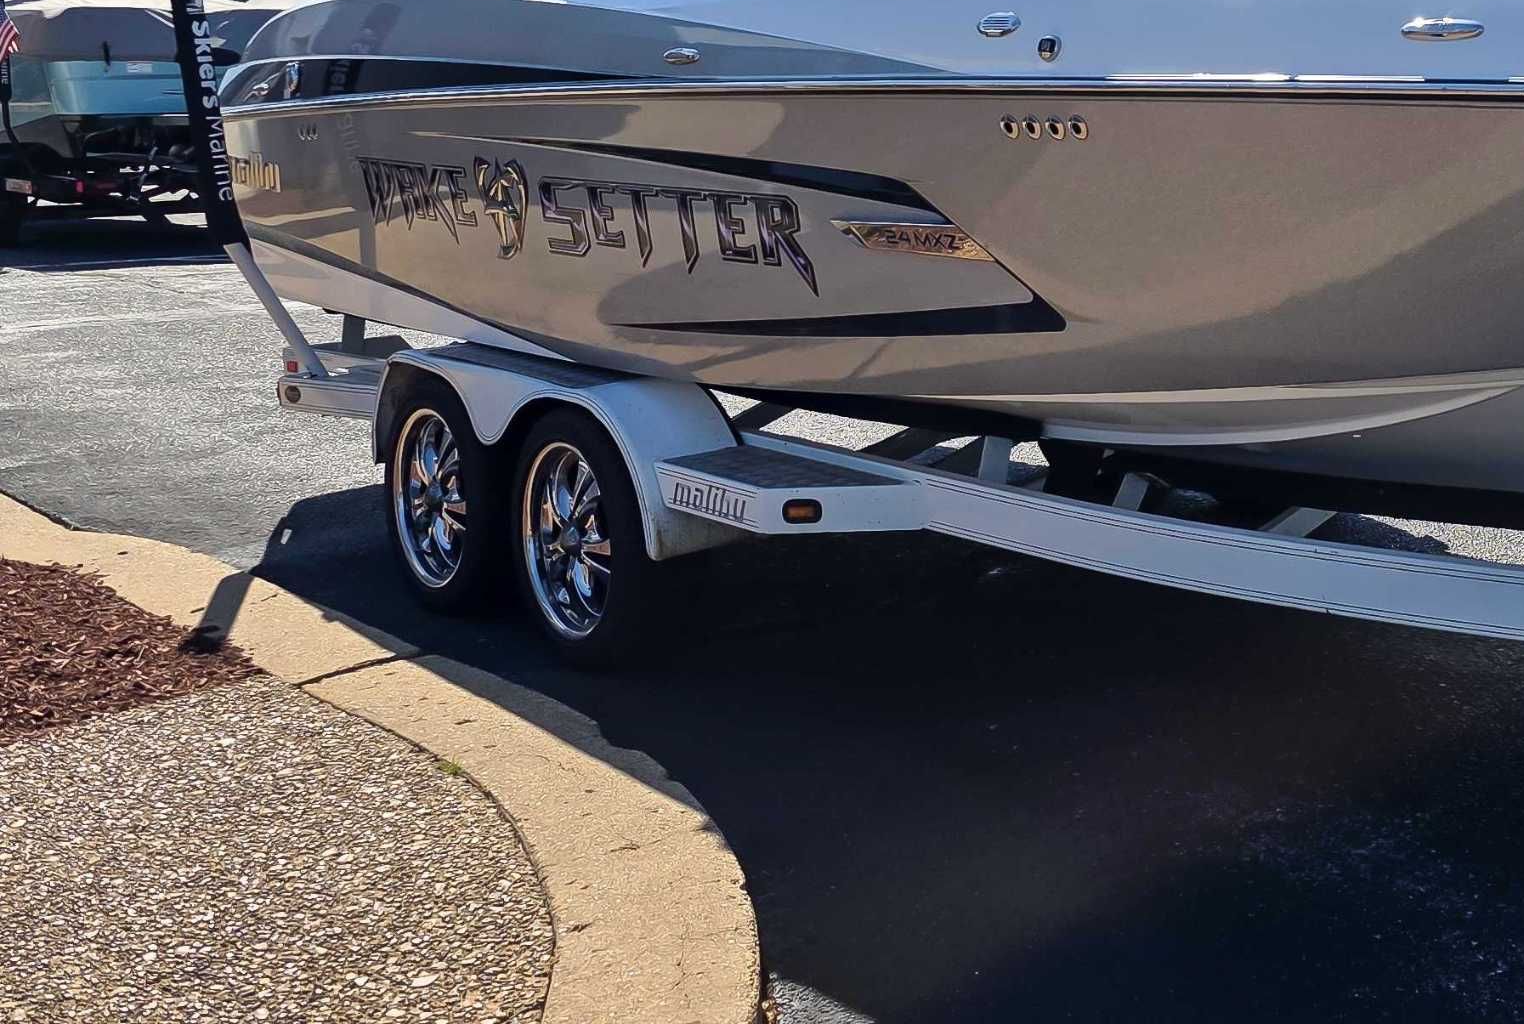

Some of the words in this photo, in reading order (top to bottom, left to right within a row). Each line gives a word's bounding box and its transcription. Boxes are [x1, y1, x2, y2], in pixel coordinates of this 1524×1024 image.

[191, 20, 218, 109] Skiers
[205, 114, 233, 202] Marine
[356, 155, 478, 248] WAKE
[538, 176, 820, 297] SETTER
[673, 482, 747, 522] malibu
